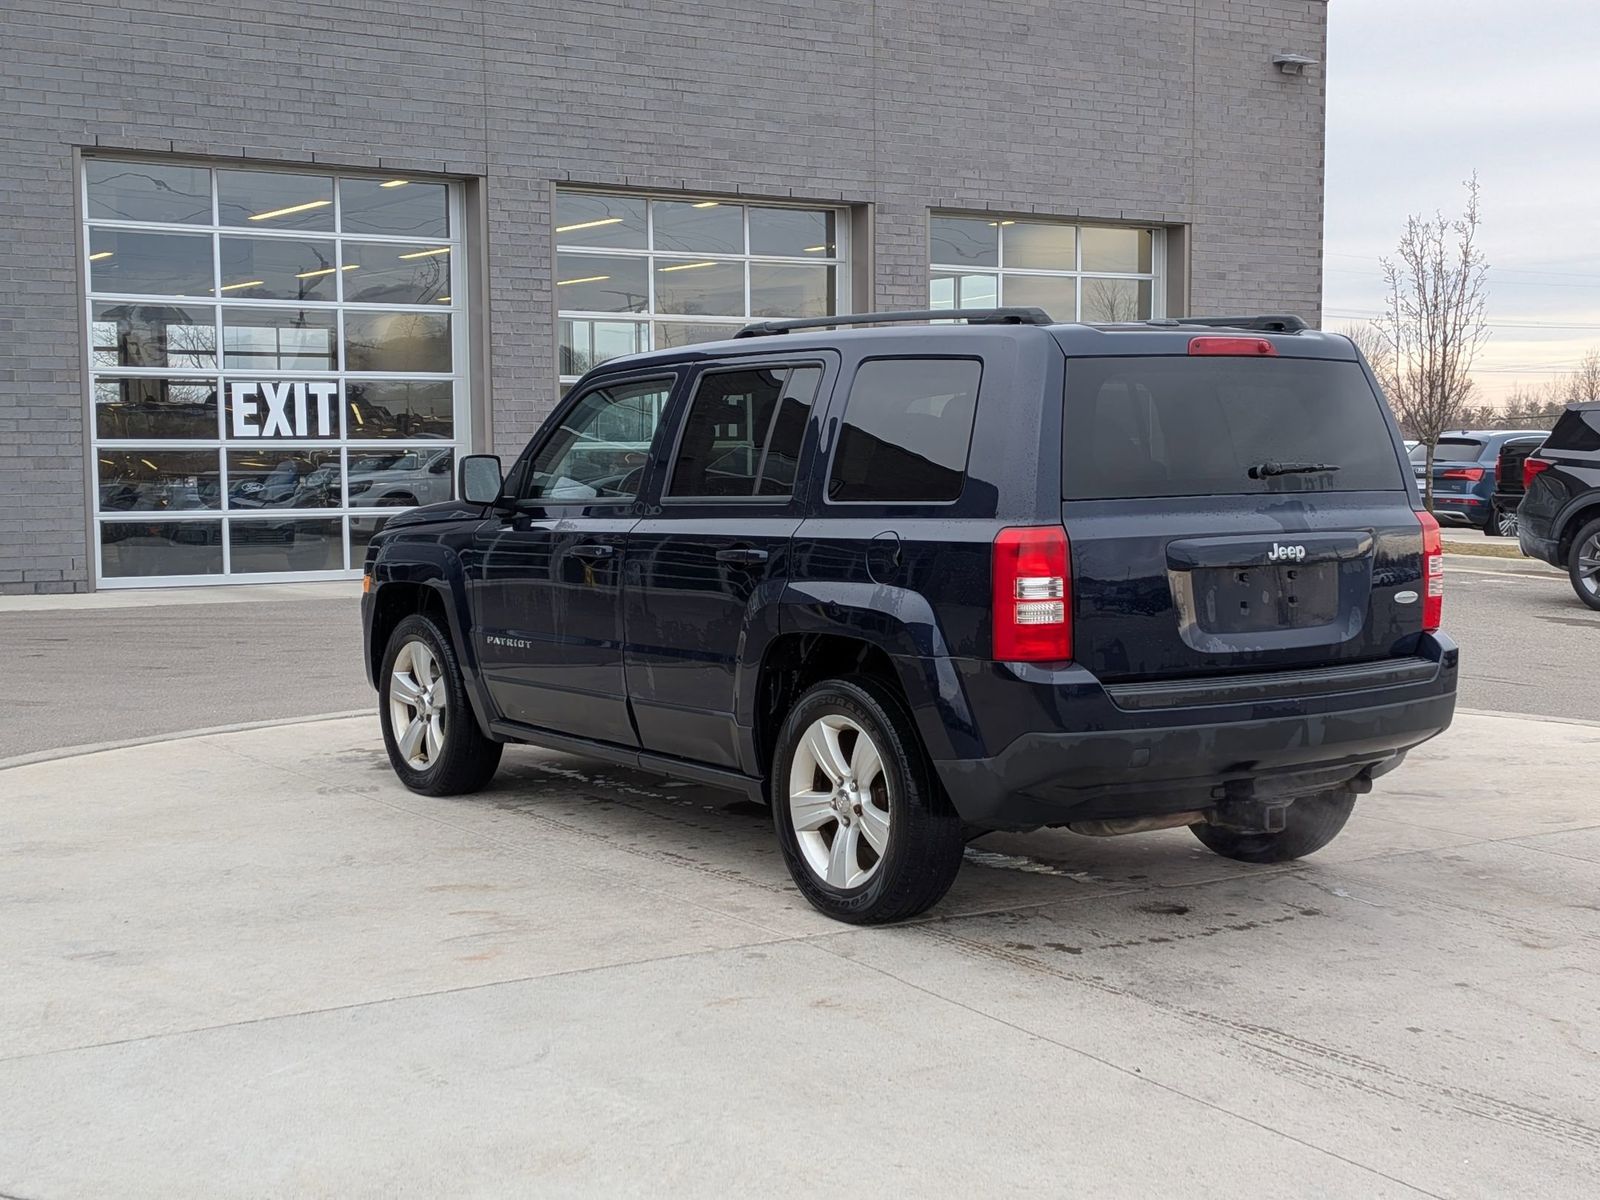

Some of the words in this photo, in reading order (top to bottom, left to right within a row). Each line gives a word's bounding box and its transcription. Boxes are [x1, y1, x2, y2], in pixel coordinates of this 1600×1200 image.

[231, 382, 337, 436] EXIT
[1268, 543, 1305, 562] Jeep
[487, 636, 532, 648] PATRIOT
